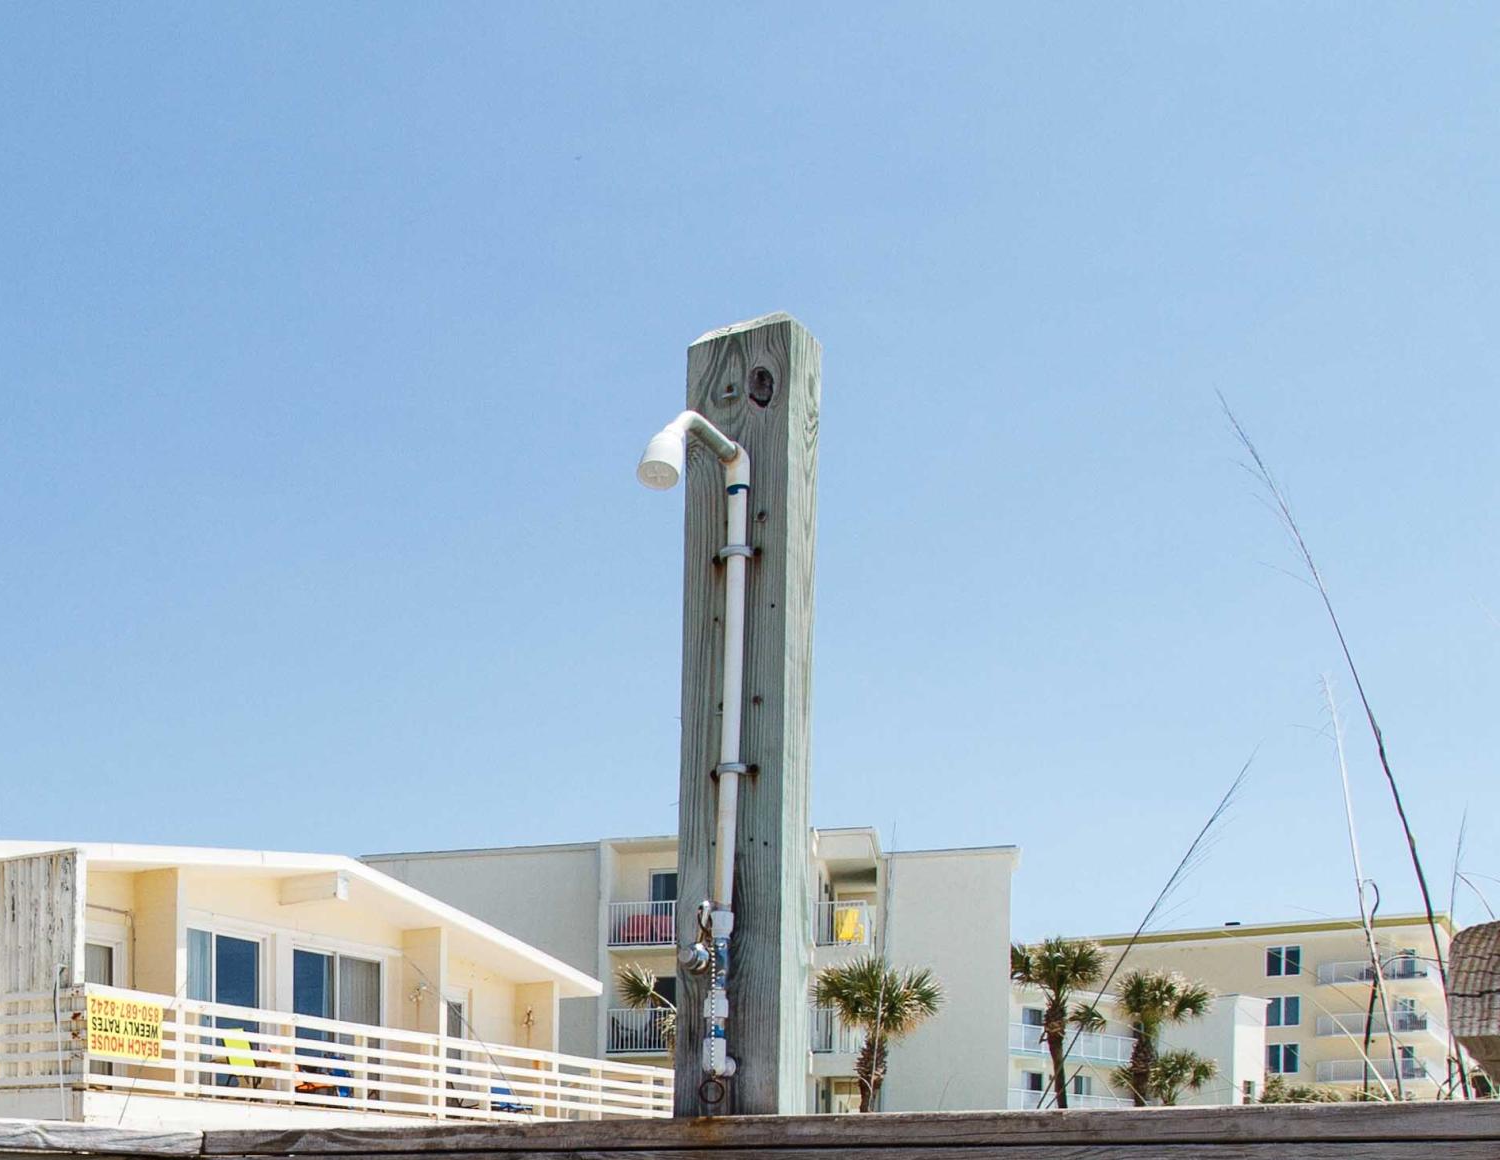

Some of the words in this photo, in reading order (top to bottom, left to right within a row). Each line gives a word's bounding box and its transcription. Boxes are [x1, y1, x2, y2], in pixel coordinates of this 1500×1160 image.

[92, 1017, 120, 1033] RATES
[123, 1021, 158, 1038] WEEKLY
[91, 1034, 124, 1052] HOUSE
[128, 1040, 159, 1057] BEACH
